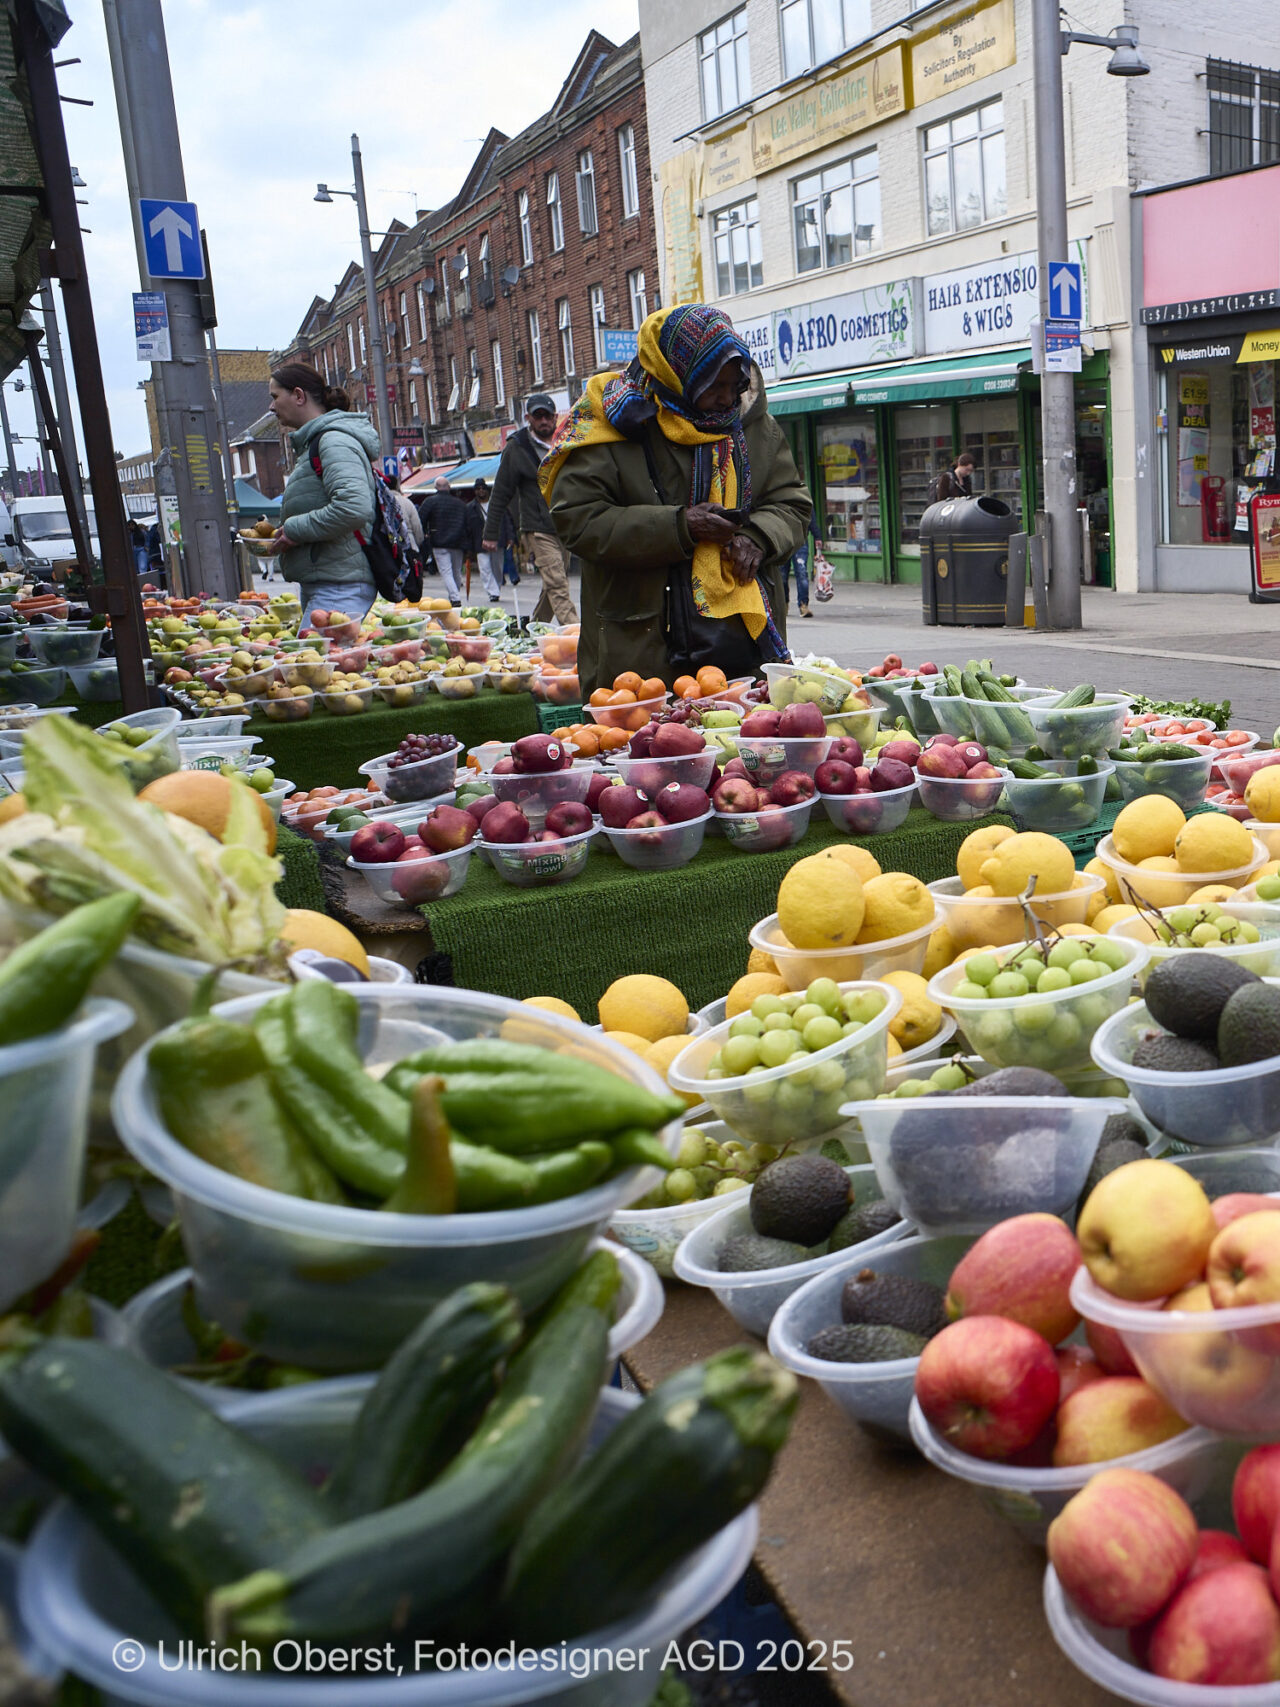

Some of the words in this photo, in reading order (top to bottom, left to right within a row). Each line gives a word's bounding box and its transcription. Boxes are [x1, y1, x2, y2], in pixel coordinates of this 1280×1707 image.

[953, 35, 963, 47] By
[924, 55, 956, 78] Solicitors
[957, 37, 996, 60] Regulation
[943, 63, 976, 85] Authority
[770, 114, 787, 140] Lee
[788, 96, 817, 131] Valley
[819, 75, 869, 118] Solicitors
[928, 281, 961, 311] HAIR
[966, 265, 1038, 303] EXTENSIO
[963, 311, 972, 336] &
[975, 303, 1013, 333] WIGS
[797, 313, 837, 353] AFRO
[841, 306, 908, 342] COSMETICS
[607, 333, 638, 341] FRES
[608, 342, 638, 350] CATC
[1251, 340, 1279, 352] Money
[615, 351, 635, 359] FIS
[1176, 348, 1207, 361] Western
[1207, 345, 1230, 358] Union
[1183, 416, 1207, 426] DEAL
[1252, 415, 1258, 428] 3
[528, 855, 567, 867] Mixing
[535, 863, 561, 875] Bowl
